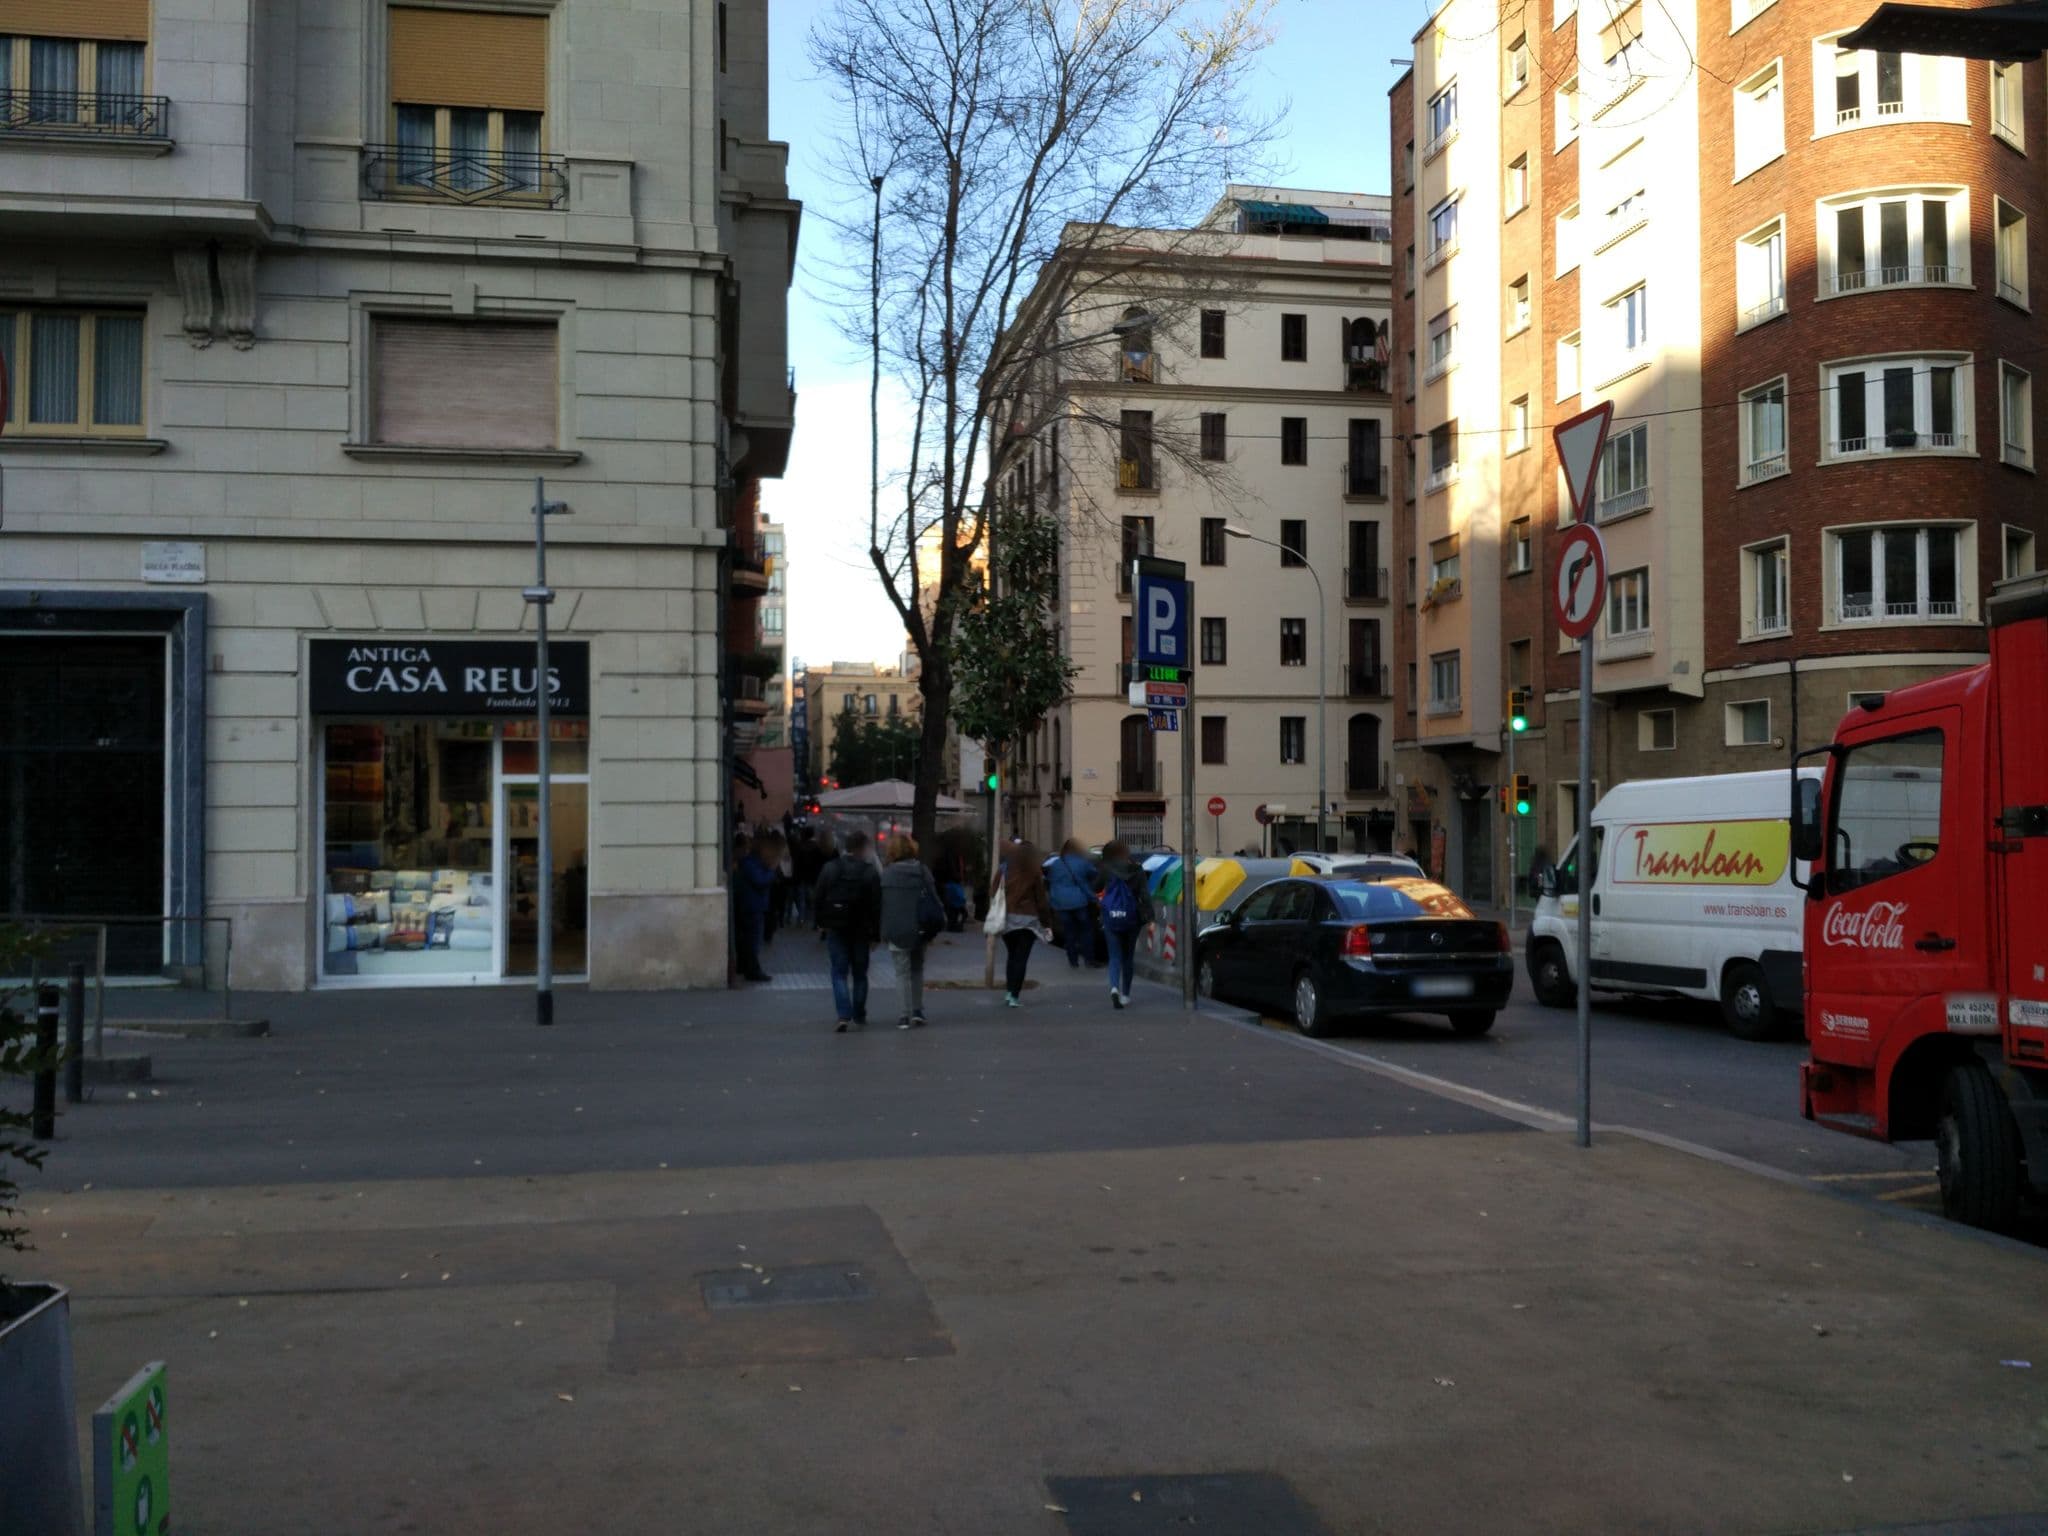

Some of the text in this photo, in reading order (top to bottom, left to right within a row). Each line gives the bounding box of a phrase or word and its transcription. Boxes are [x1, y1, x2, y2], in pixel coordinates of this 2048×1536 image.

[1148, 586, 1177, 654] P
[347, 647, 432, 663] ANTIGA
[345, 665, 562, 693] CASA REUS
[1634, 828, 1764, 878] Transloan
[1703, 903, 1788, 918] www.transloan.es
[1823, 901, 1909, 949] Coca-Cola
